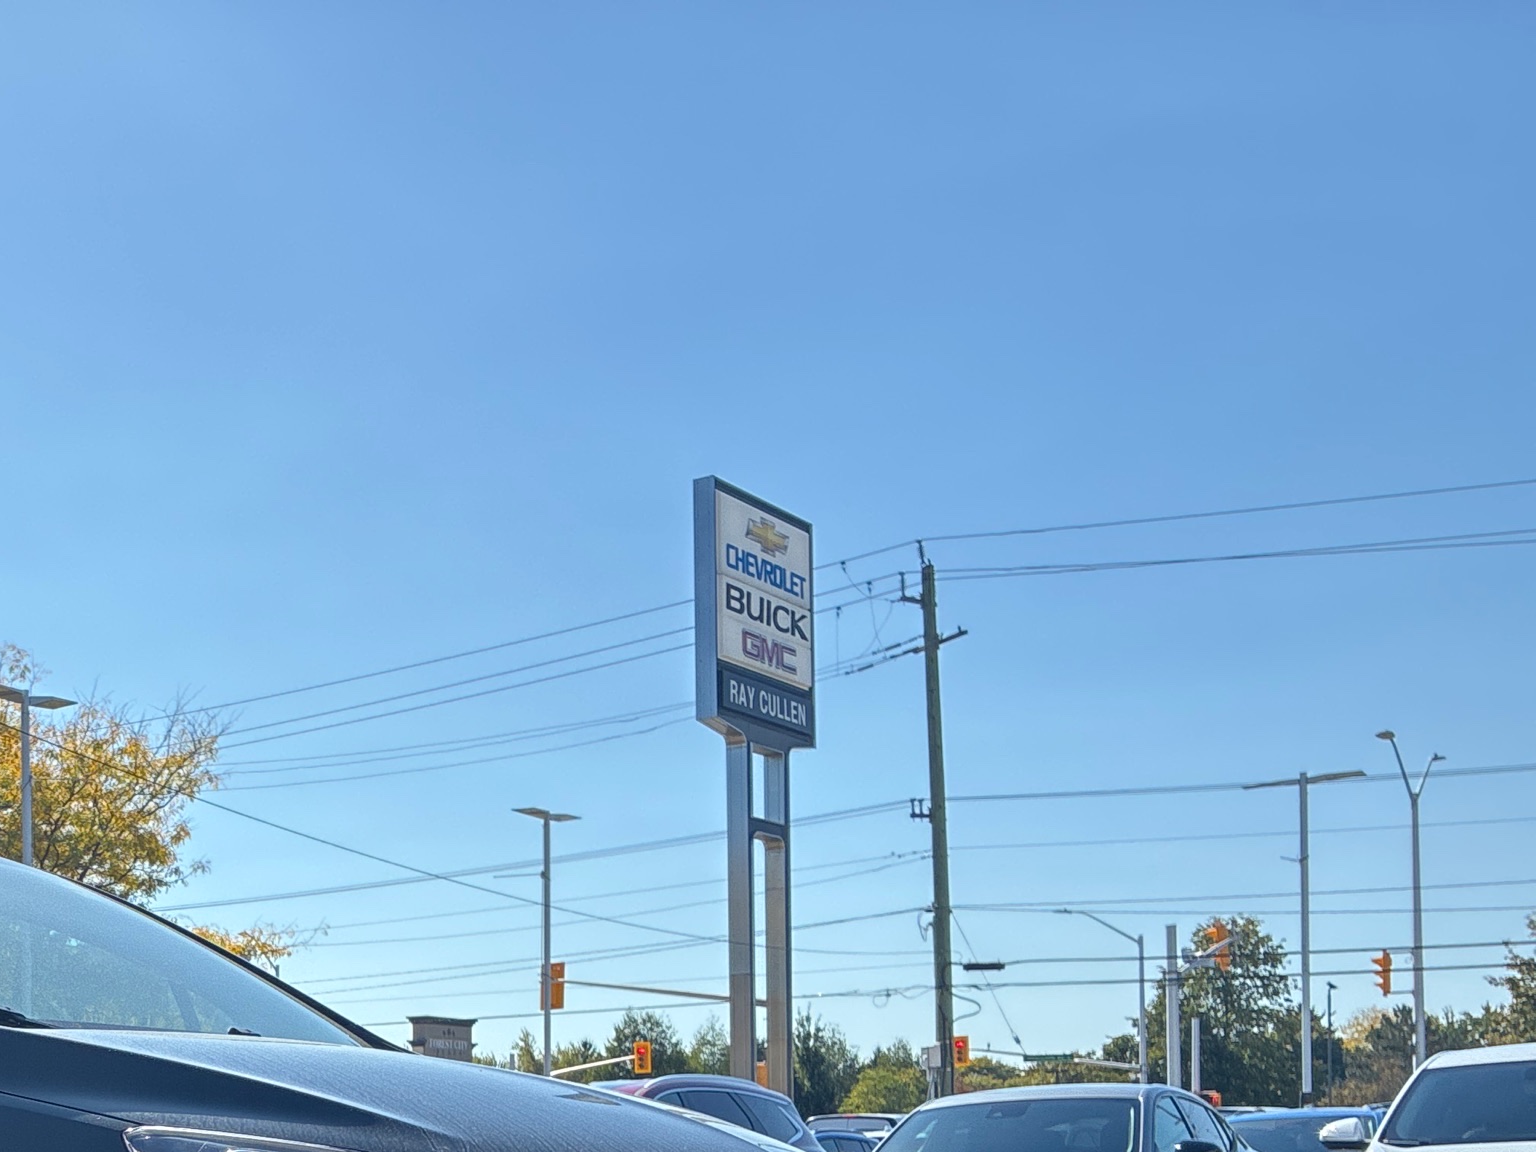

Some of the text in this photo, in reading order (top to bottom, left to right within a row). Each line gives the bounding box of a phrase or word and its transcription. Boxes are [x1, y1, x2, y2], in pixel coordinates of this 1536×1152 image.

[726, 543, 806, 599] CHEVROLET
[726, 582, 809, 642] BUICK
[742, 628, 797, 675] GMC
[730, 679, 807, 727] RAY CULLEN
